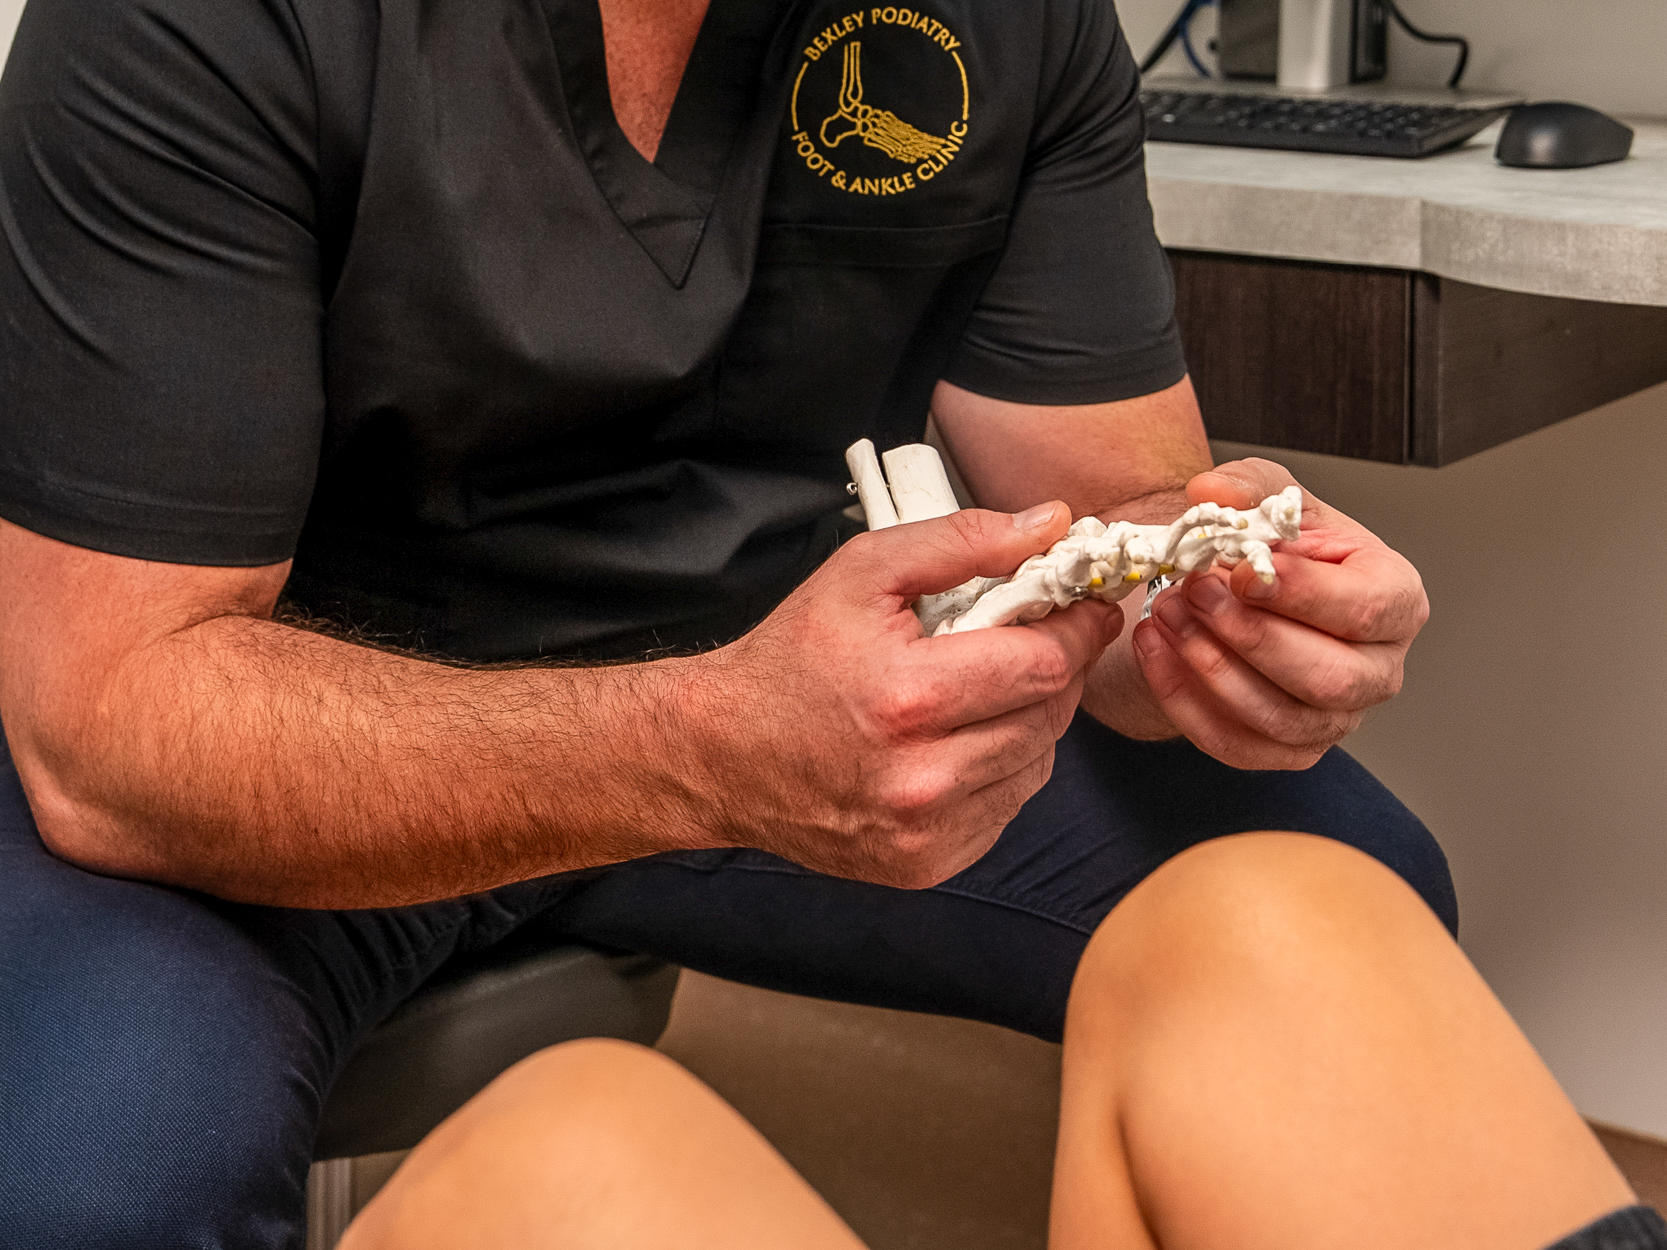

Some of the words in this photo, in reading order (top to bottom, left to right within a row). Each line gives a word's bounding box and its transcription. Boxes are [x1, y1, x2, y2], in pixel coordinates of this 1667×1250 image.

[804, 10, 864, 61] BEXLEY
[871, 6, 961, 52] PODIATRY
[792, 131, 835, 177] FOOT
[830, 170, 847, 190] &
[848, 172, 916, 196] ANKLE
[916, 121, 968, 181] CLINIC
